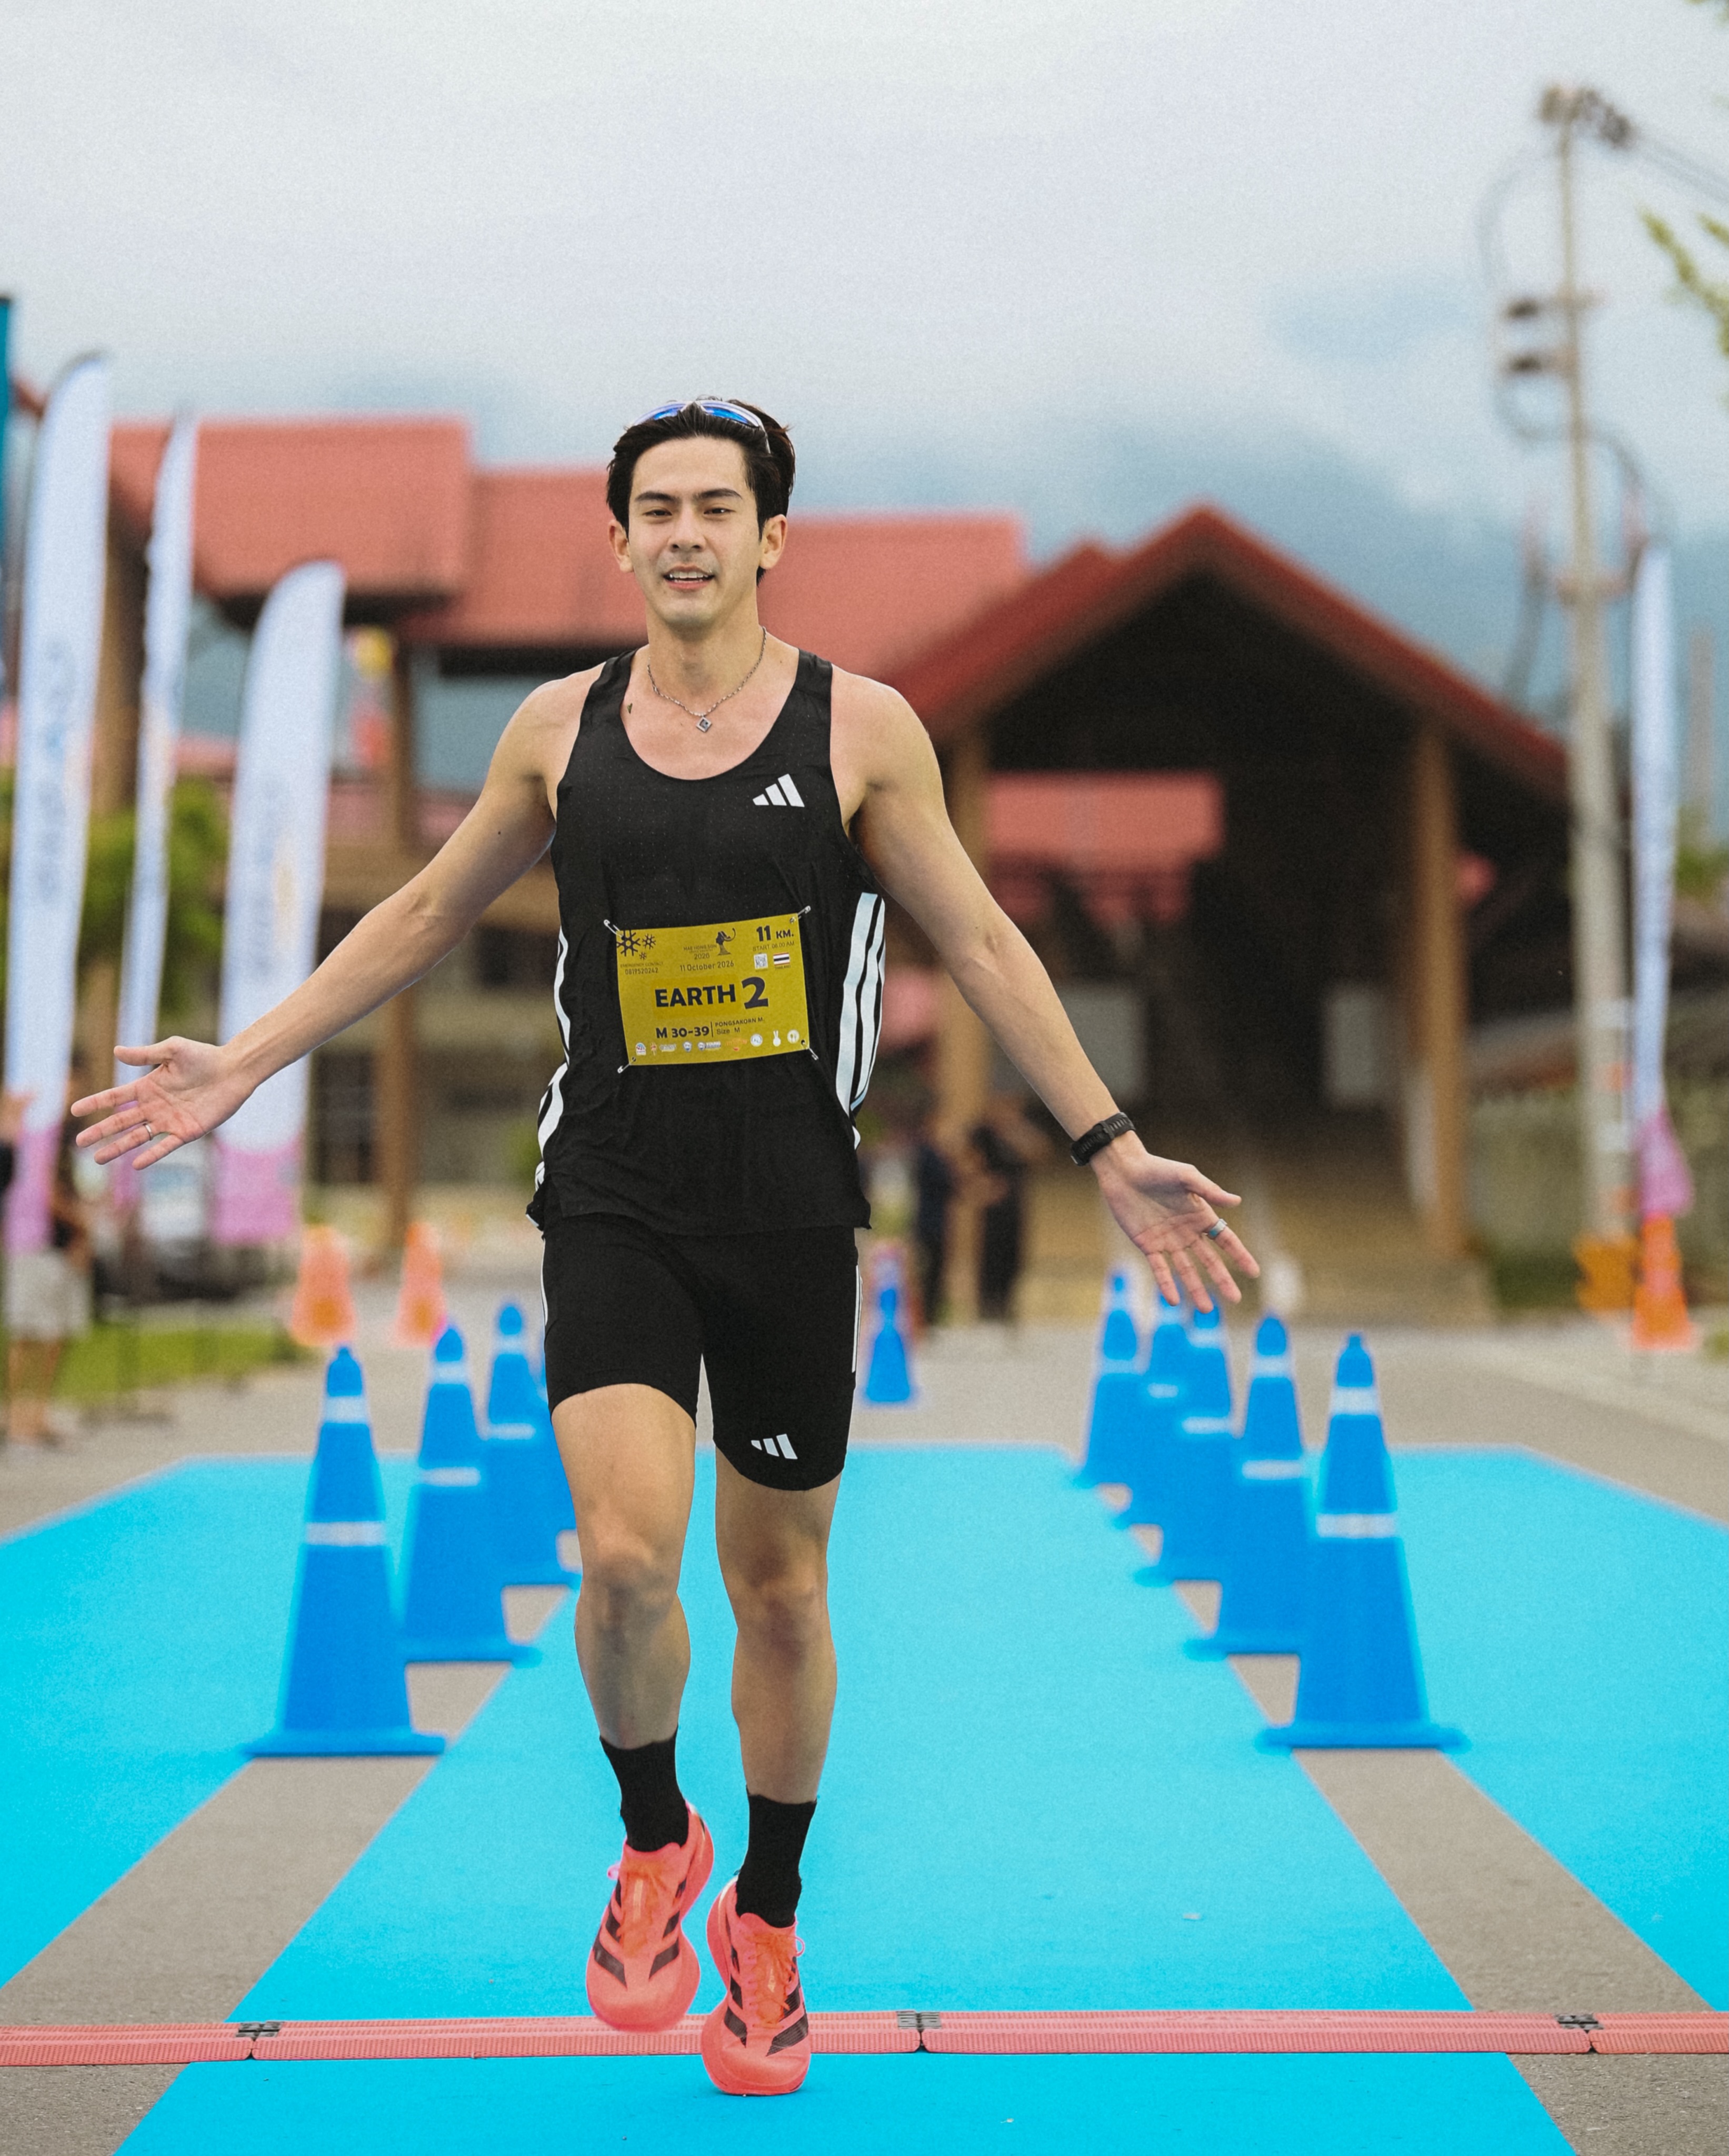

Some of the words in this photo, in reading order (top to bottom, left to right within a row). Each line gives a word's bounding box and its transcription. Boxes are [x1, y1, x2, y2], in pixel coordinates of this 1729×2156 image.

[756, 925, 771, 942] 11
[776, 929, 794, 939] KM.
[687, 963, 715, 971] October
[717, 960, 734, 969] 2026
[655, 983, 736, 1007] EARTH
[741, 976, 768, 1009] 2
[715, 1018, 756, 1027] PONGSAKORN
[656, 1027, 668, 1039] M
[672, 1026, 709, 1038] 30-39
